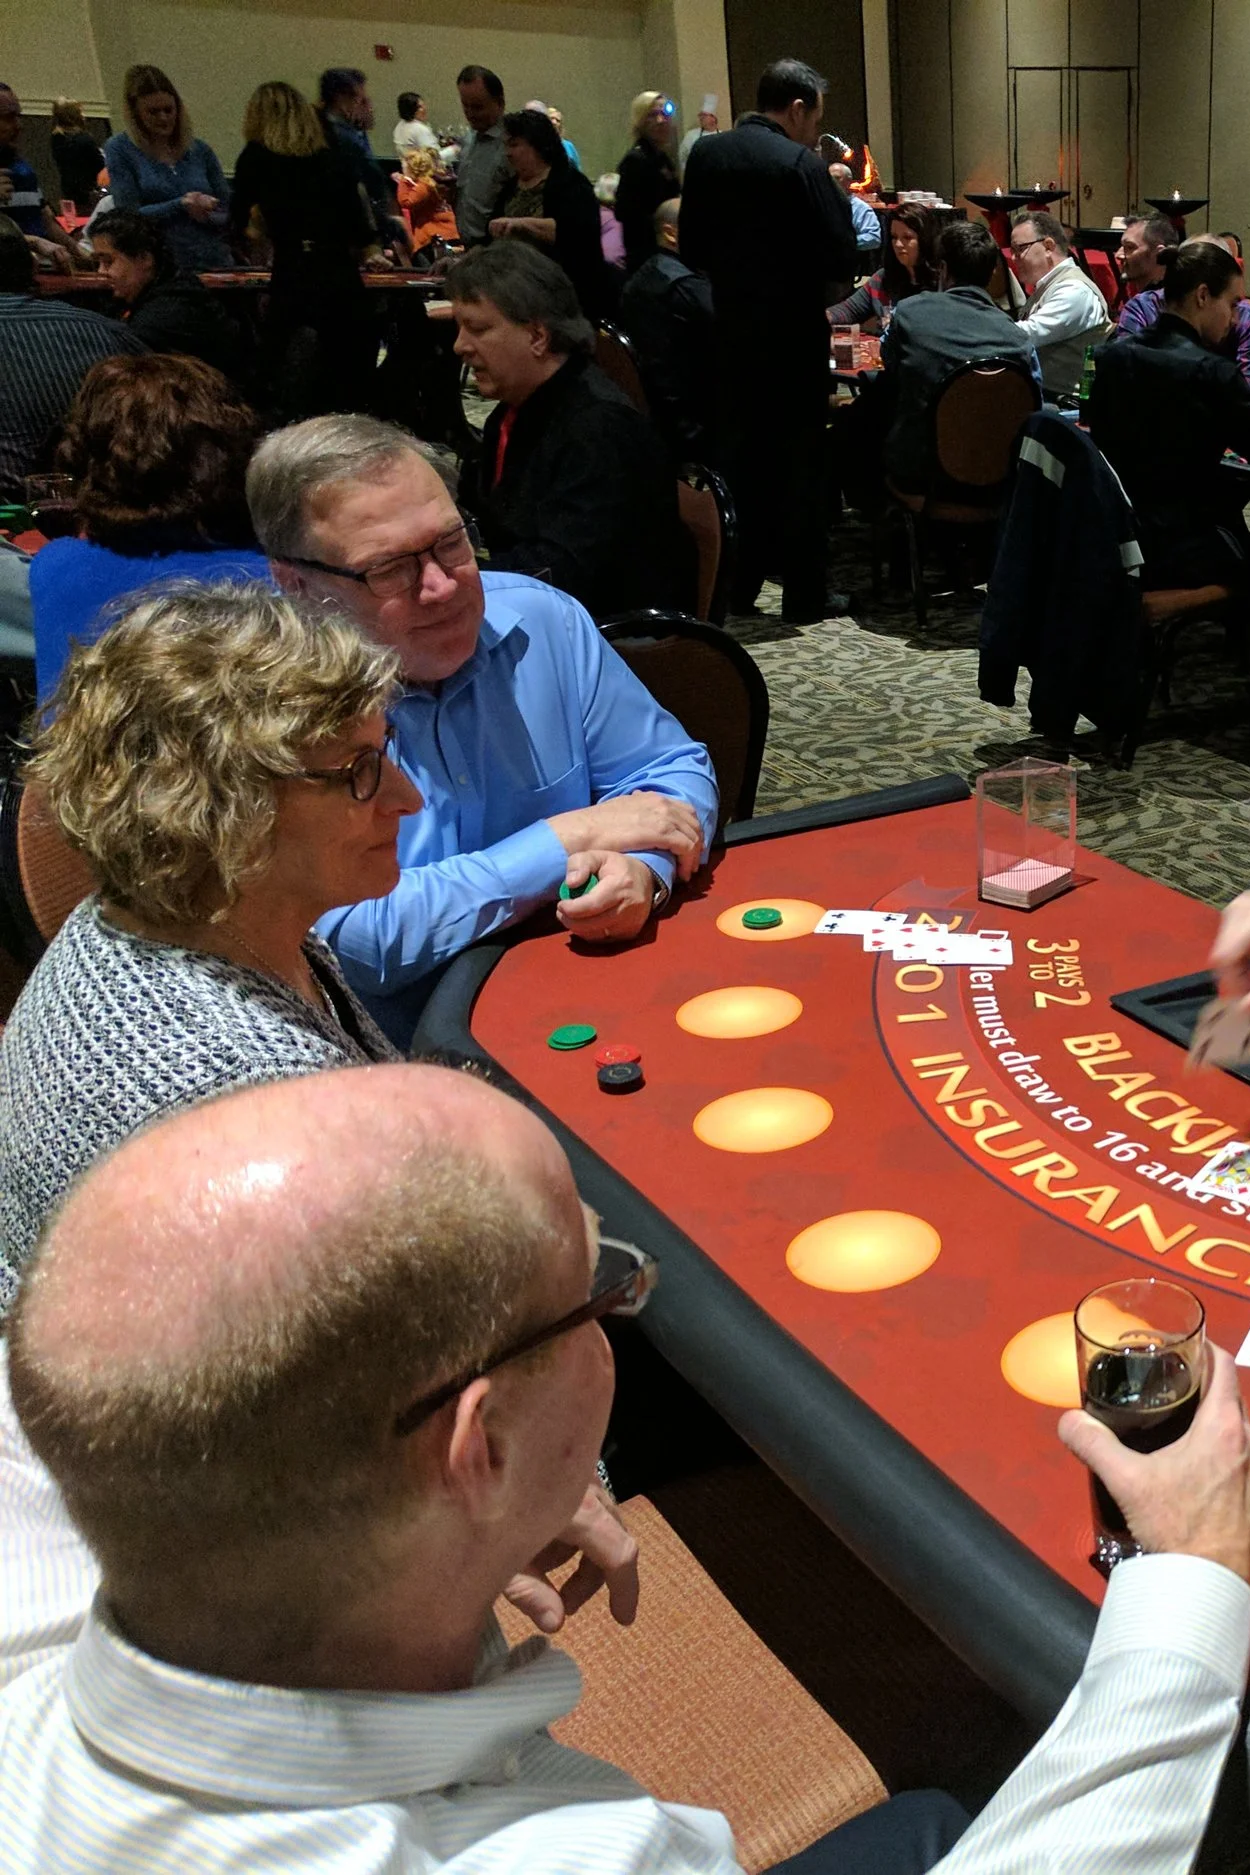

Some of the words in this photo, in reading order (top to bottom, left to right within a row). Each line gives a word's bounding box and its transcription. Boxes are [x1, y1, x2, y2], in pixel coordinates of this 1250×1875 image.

[971, 929, 1010, 992] Dler
[1026, 937, 1081, 954] 3
[1028, 961, 1055, 981] TO
[1053, 955, 1085, 988] PAYS
[896, 1003, 948, 1023] 1
[1034, 990, 1092, 1009] 2
[972, 995, 1017, 1049] must
[998, 1050, 1064, 1104] draw
[1051, 1104, 1093, 1132] to
[1092, 1130, 1150, 1162] 16
